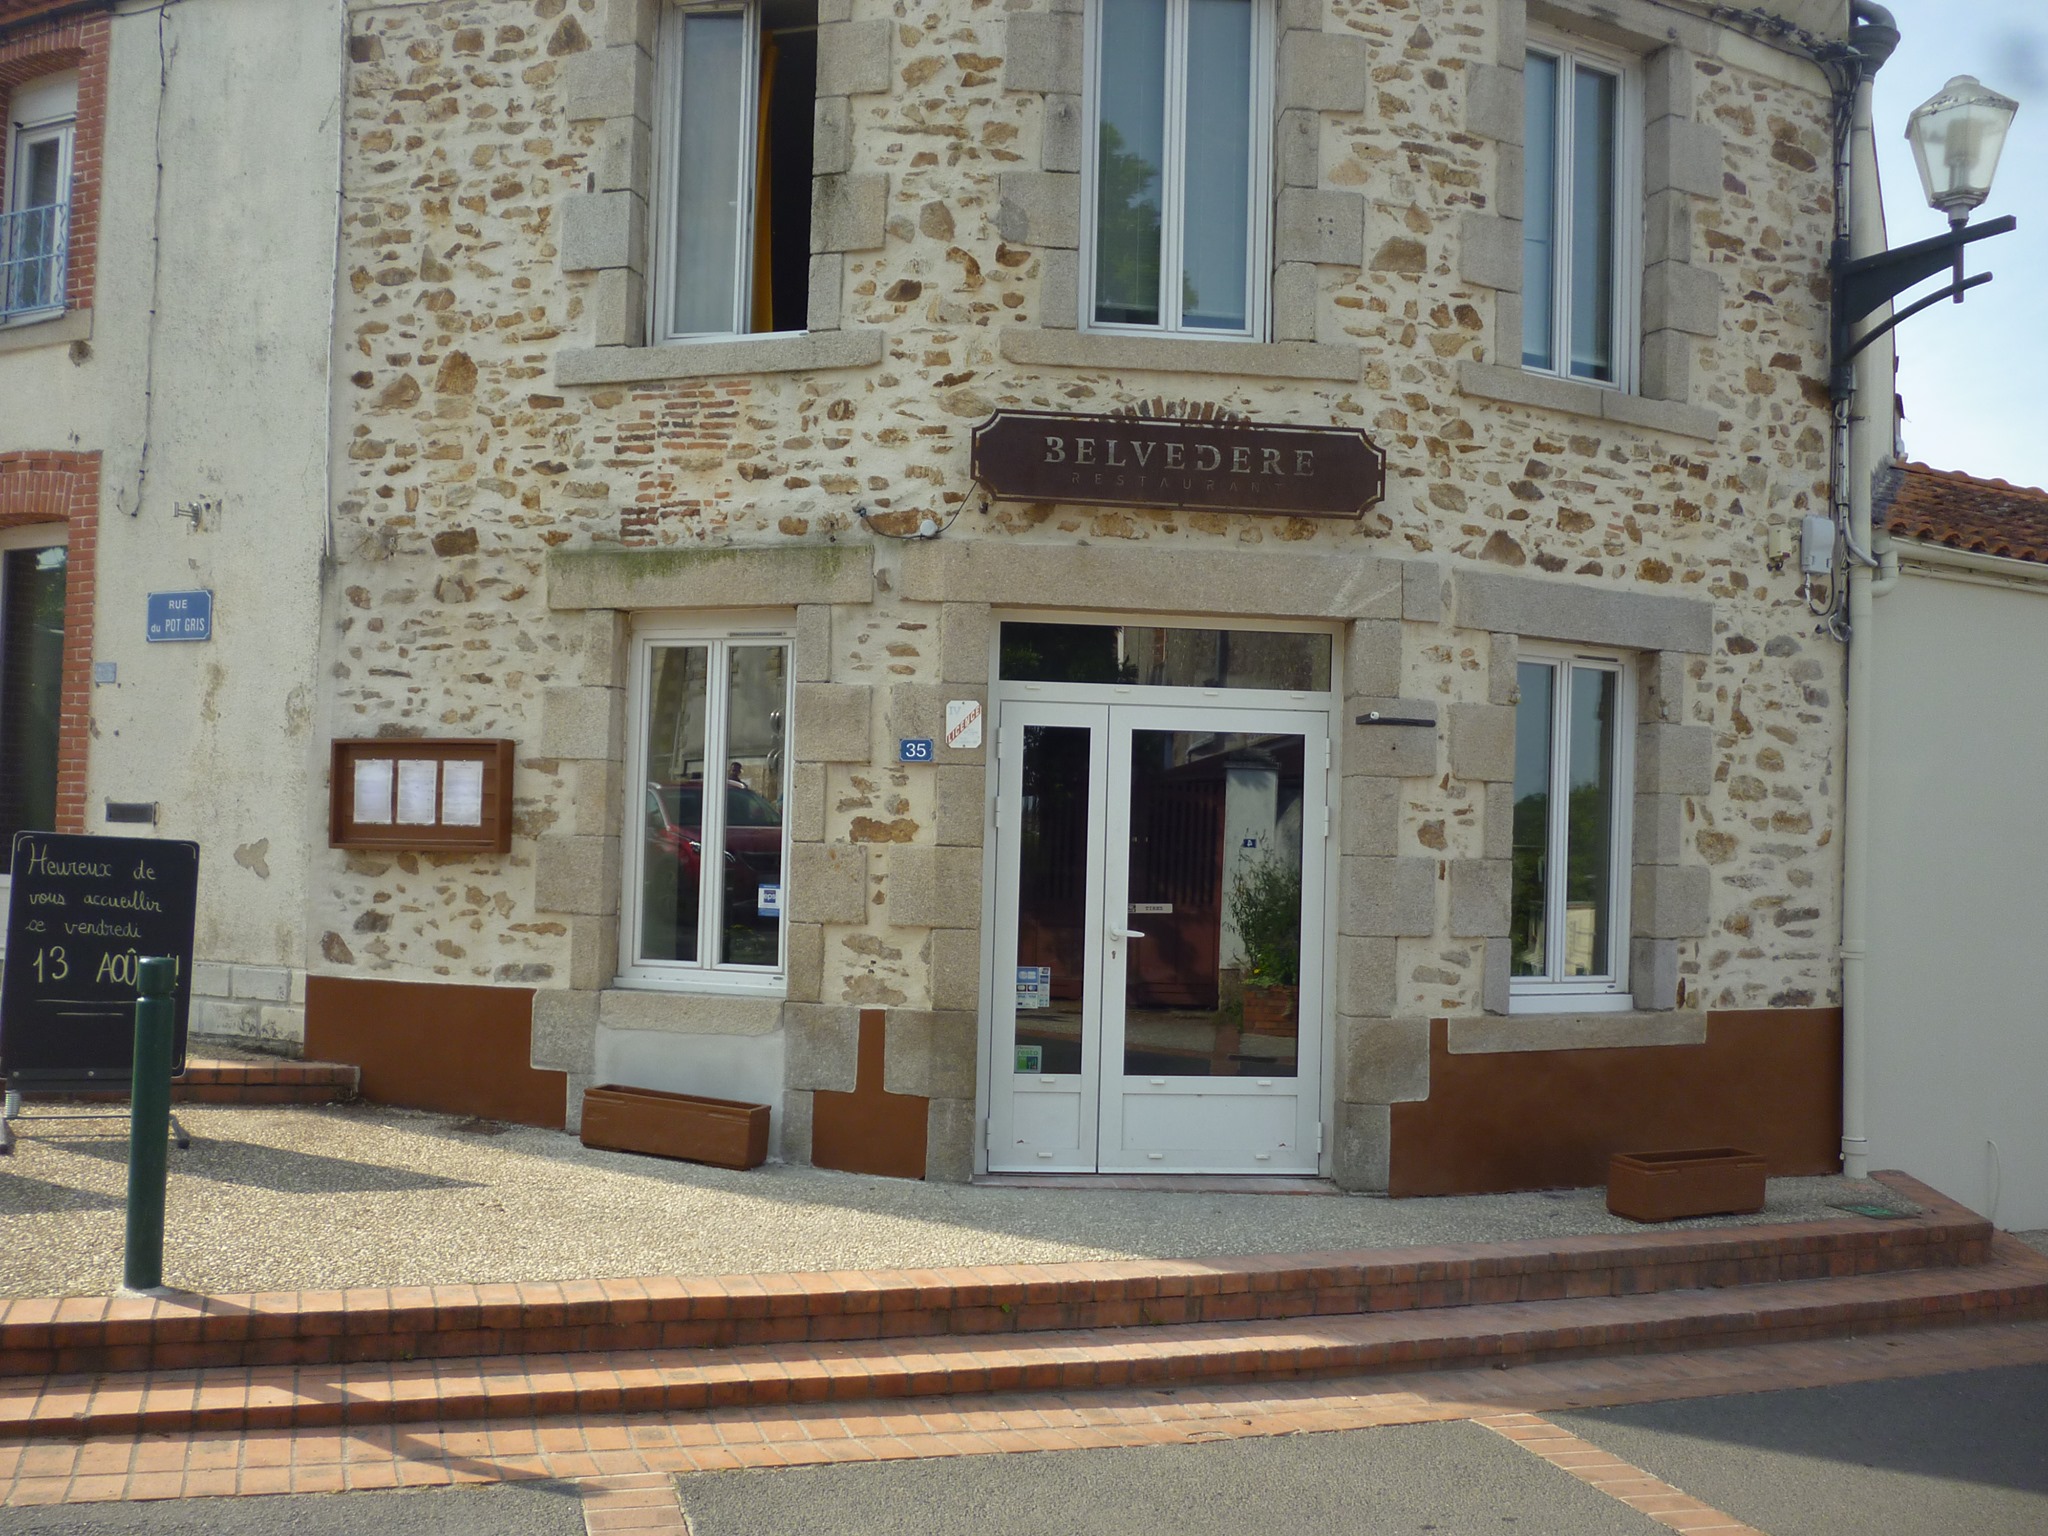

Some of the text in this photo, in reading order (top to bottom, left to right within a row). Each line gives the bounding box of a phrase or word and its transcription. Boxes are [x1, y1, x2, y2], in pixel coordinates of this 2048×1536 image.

[1044, 436, 1315, 476] BELVEDERE
[1071, 471, 1286, 493] RESTAURANT
[168, 599, 188, 609] RUE
[150, 617, 205, 633] du POT GRIS
[946, 705, 982, 745] LICENCE
[905, 742, 927, 758] 35
[28, 843, 156, 880] Heureux de
[29, 891, 162, 912] vous accueillir
[25, 919, 141, 938] ce vendredi
[33, 946, 69, 984] 13
[96, 948, 139, 986] AOÛ
